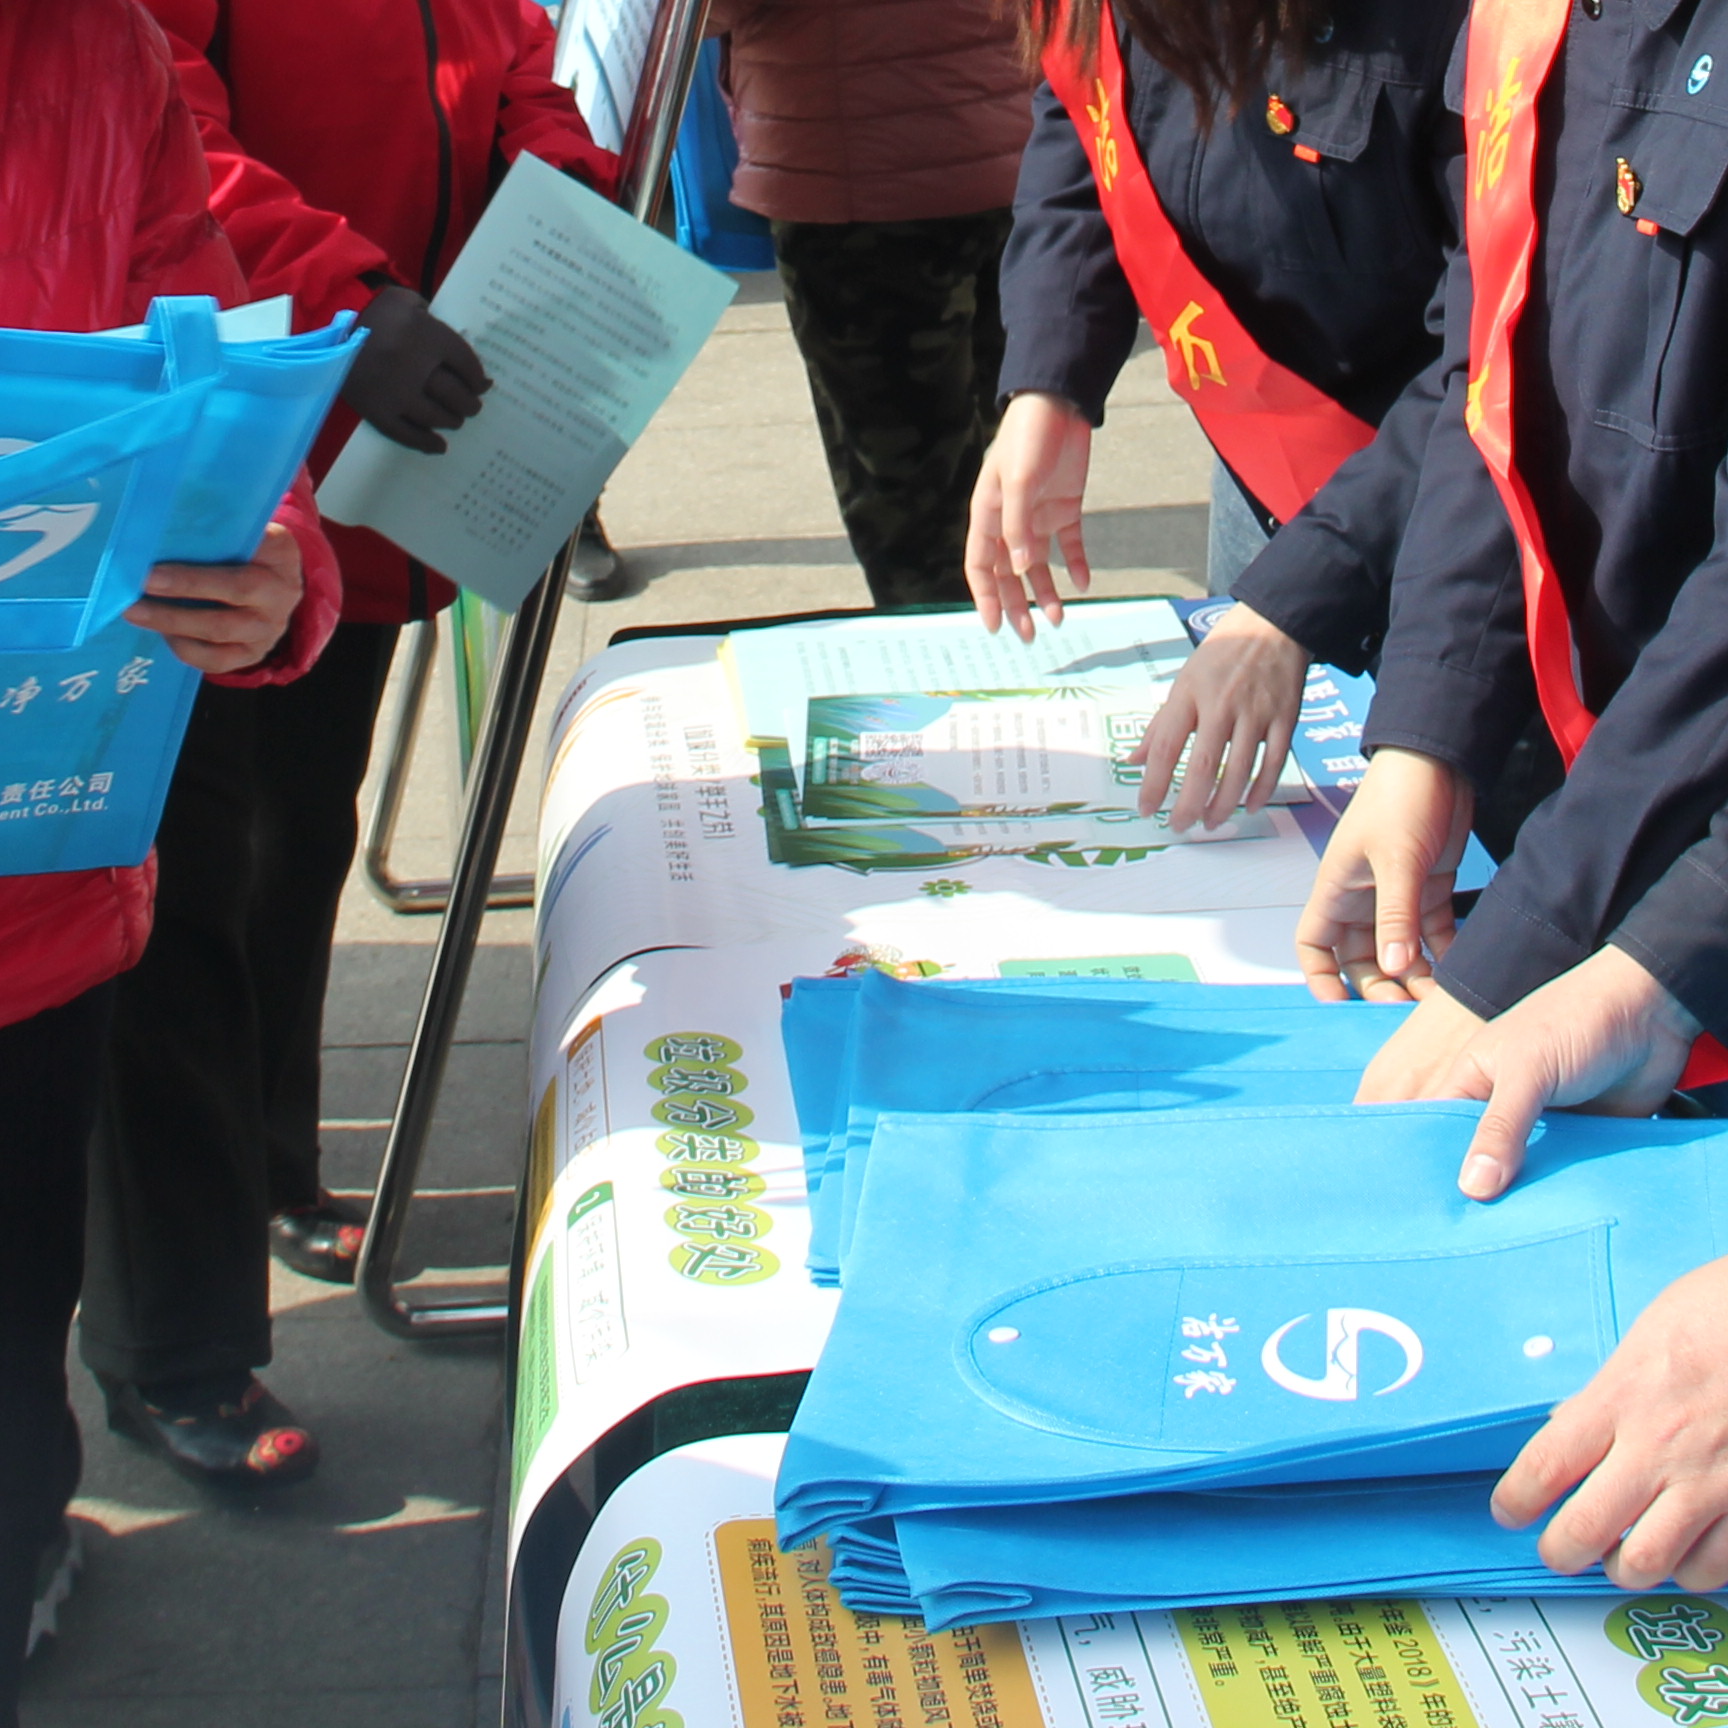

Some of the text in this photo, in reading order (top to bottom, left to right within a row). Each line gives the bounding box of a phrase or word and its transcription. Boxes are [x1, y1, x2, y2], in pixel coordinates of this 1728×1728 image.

[659, 1035, 763, 1279] 垃圾分类的好处
[1172, 1312, 1241, 1400] 洁万家
[1073, 1612, 1151, 1728] 气，威胁
[1472, 1598, 1585, 1728] ，污染土壤
